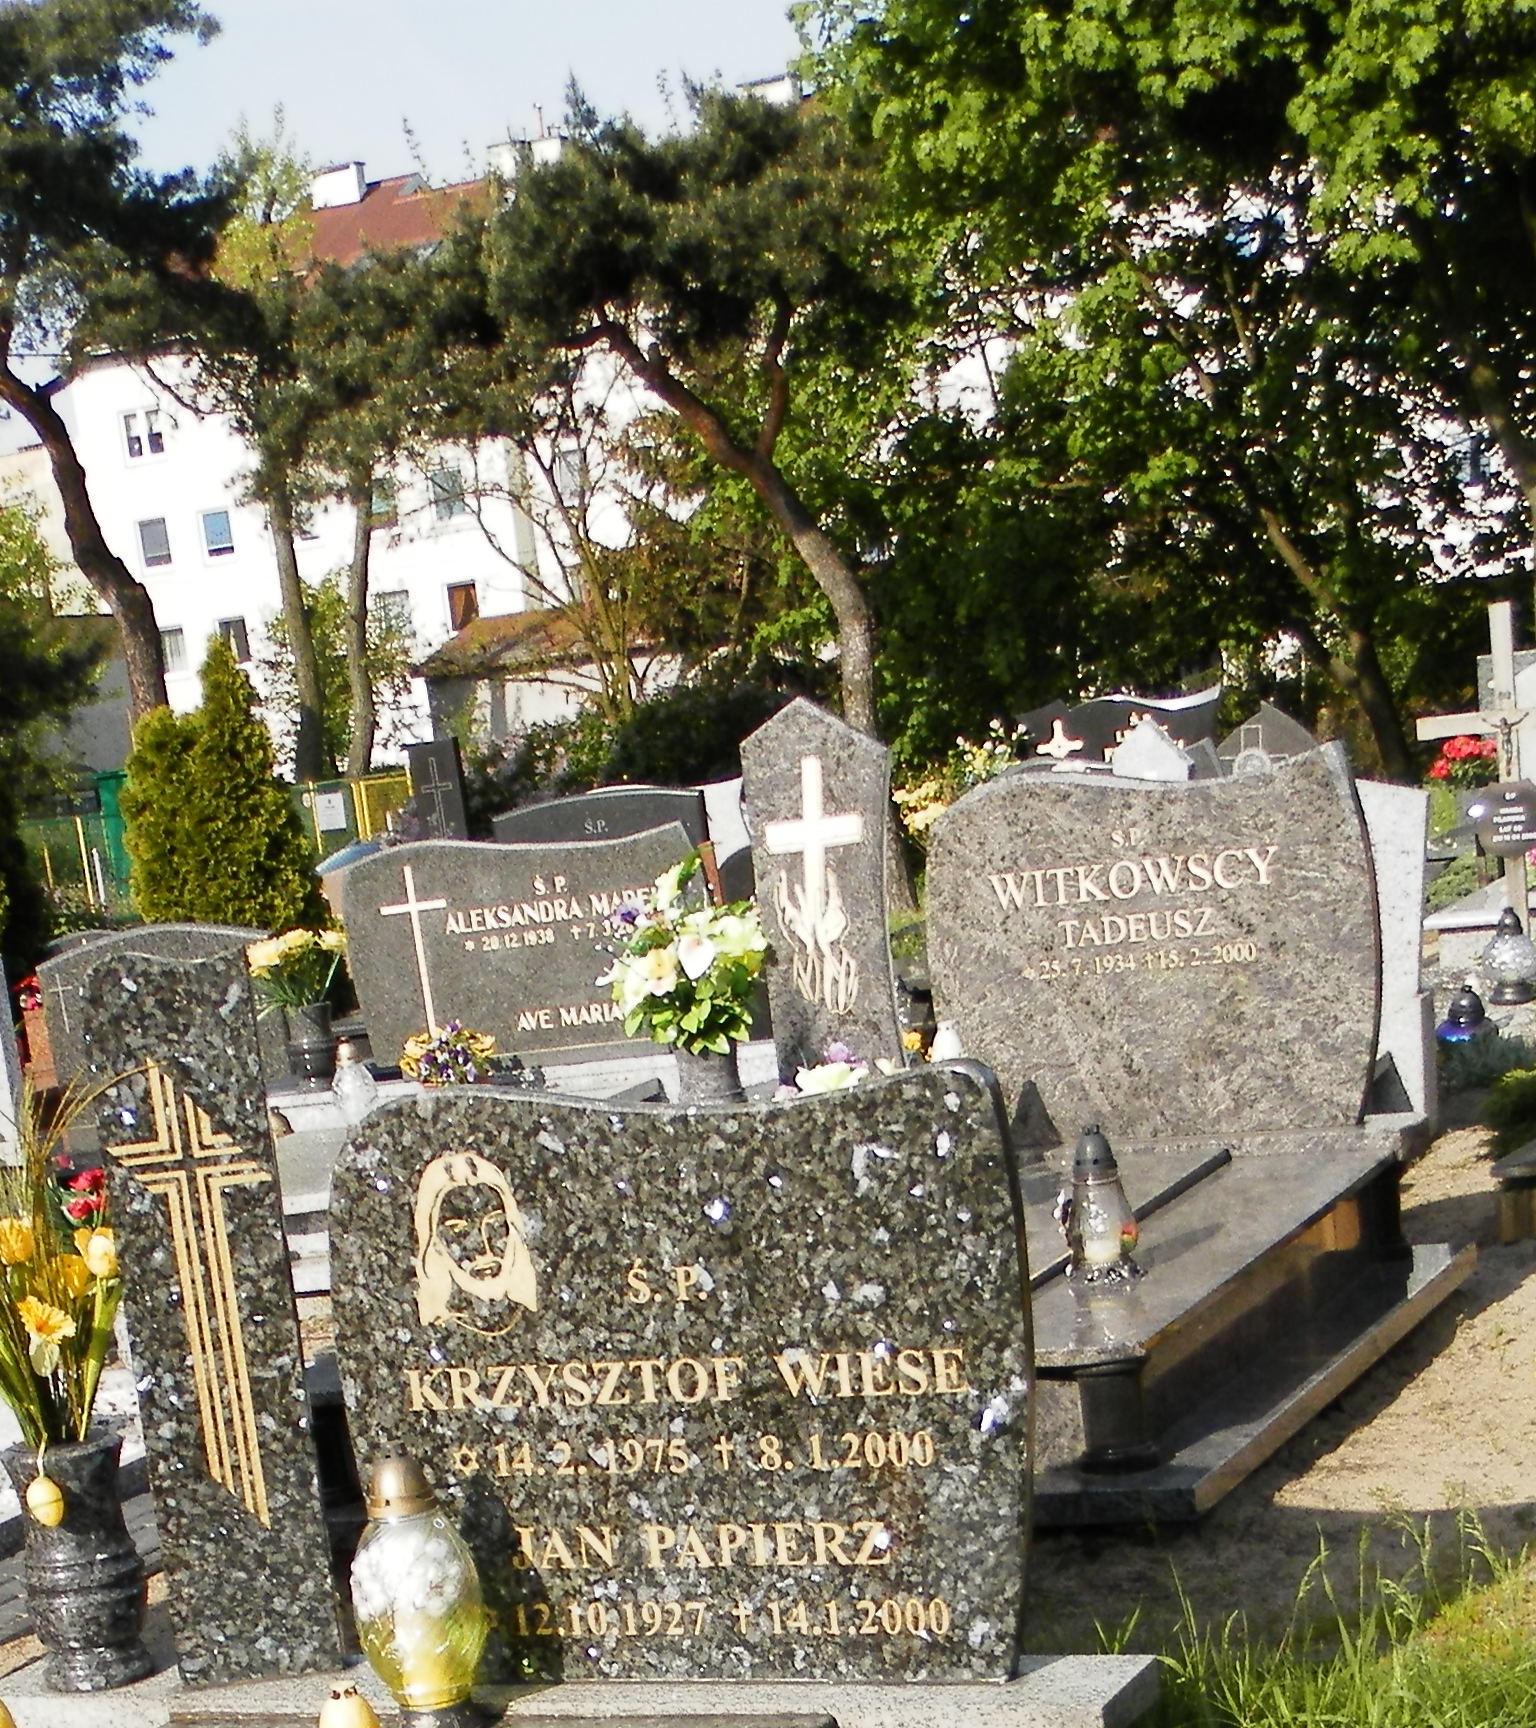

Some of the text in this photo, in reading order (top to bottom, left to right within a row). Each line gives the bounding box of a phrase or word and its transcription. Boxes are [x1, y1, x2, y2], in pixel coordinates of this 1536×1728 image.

[988, 847, 1278, 911] WITKOWSCY
[446, 897, 583, 935] ALEKSANDRA
[1058, 907, 1216, 948] TADEUSZ
[1095, 953, 1136, 974] 1934
[517, 1002, 624, 1032] AVE MARIA
[404, 1348, 973, 1411] KRZYSZTOF WIESE
[512, 1519, 892, 1570] JAN PAPIERZ
[514, 1597, 952, 1637] 12.10.1927 14.1.2000
